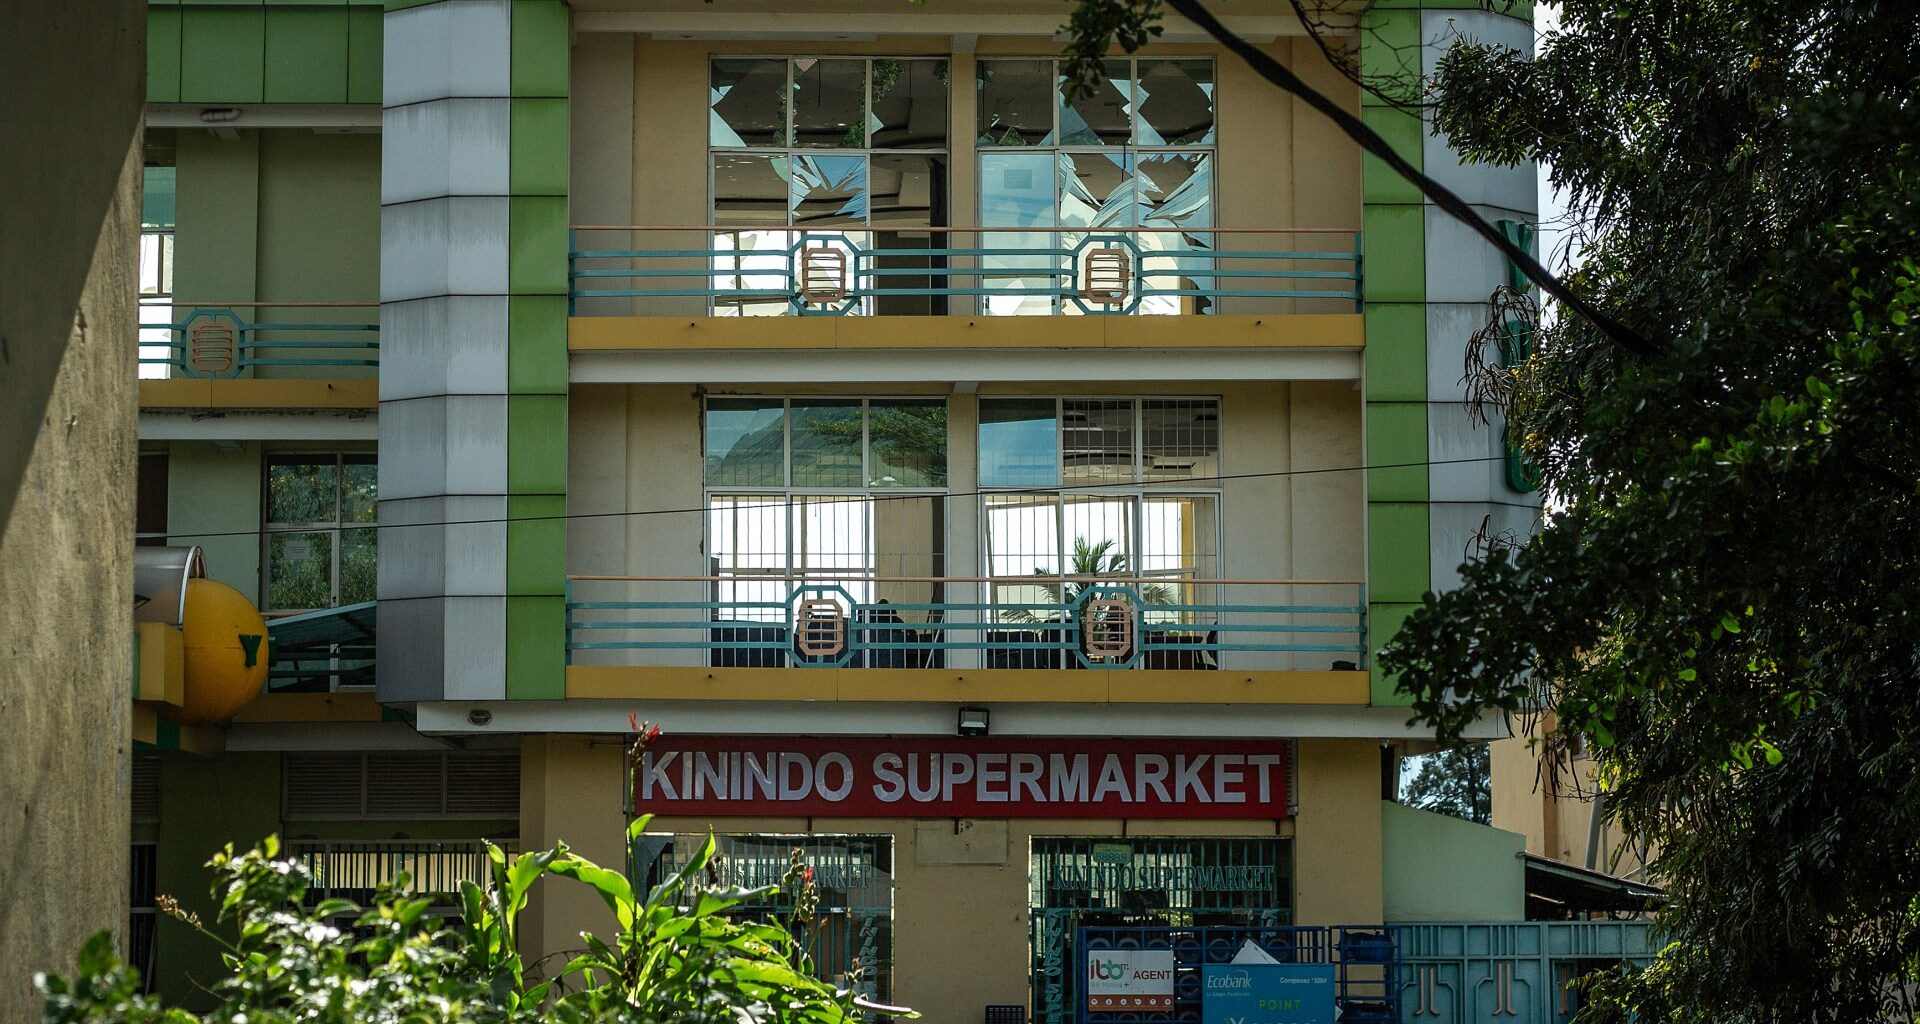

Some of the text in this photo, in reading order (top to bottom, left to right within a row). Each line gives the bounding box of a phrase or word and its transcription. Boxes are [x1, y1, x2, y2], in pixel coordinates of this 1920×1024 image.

[641, 751, 1280, 803] KININDO SUPERMARKET
[1052, 865, 1274, 891] KININDO SUPERMARKET
[1133, 970, 1172, 980] AGENT
[1207, 973, 1252, 989] Ecobank
[1279, 977, 1310, 985] Composez
[1258, 999, 1302, 1011] POINT
